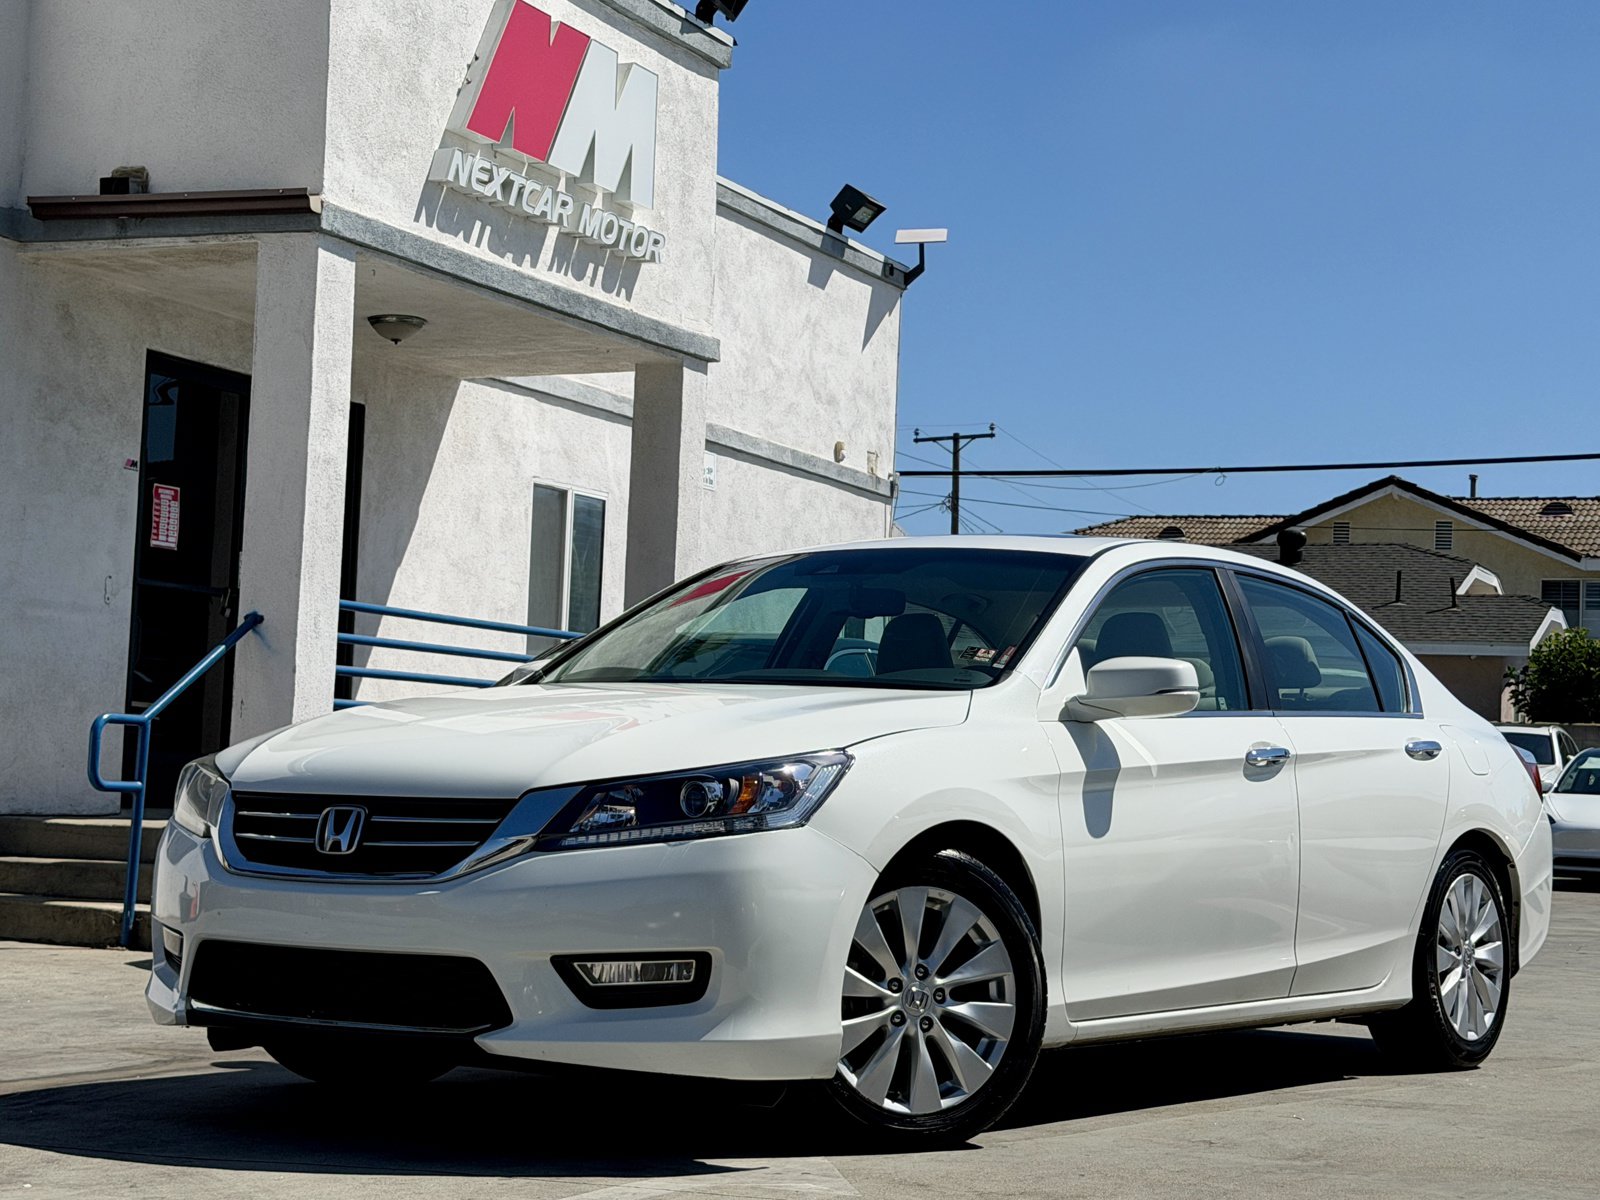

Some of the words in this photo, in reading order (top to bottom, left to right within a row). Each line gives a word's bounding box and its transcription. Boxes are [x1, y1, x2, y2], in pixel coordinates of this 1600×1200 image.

[466, 0, 658, 210] NM
[447, 149, 574, 228] NEXTCAR
[578, 203, 666, 264] MOTOR
